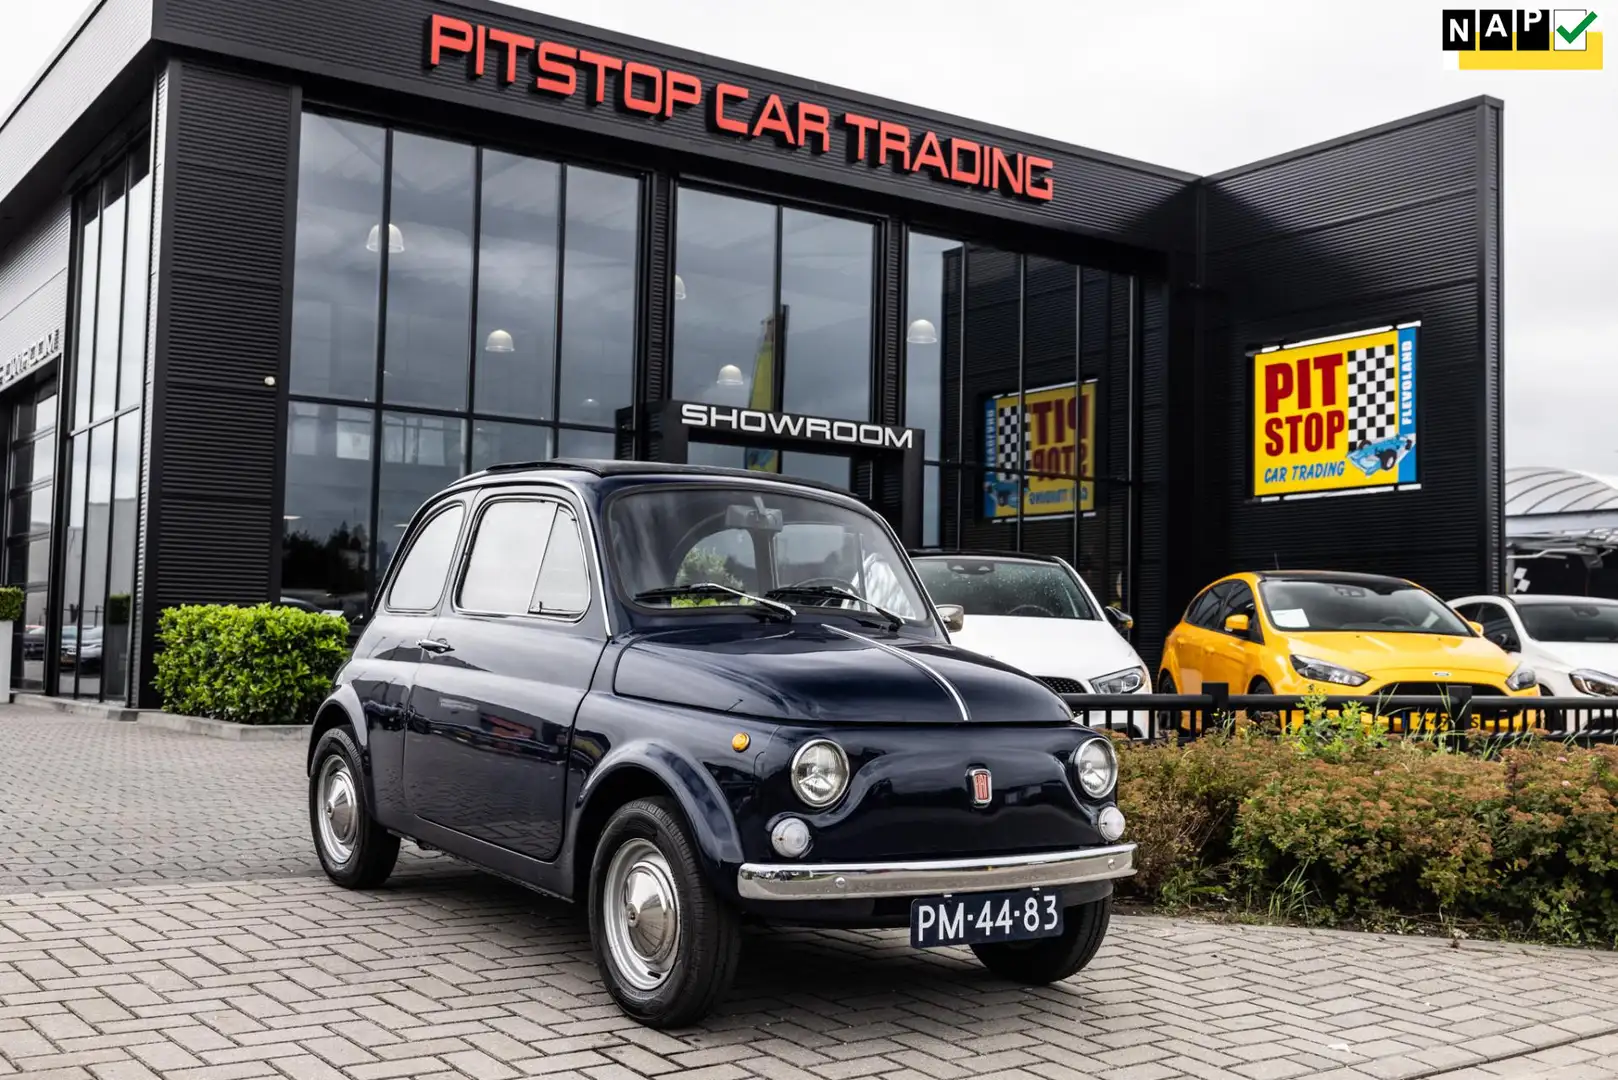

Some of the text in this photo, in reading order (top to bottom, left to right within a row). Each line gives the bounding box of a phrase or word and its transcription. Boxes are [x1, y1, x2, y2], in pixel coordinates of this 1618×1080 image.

[431, 14, 1054, 201] PITSTOP CAR TRADING
[1265, 353, 1343, 414] PIT
[1401, 341, 1414, 426] FLEVOLAND
[681, 403, 913, 449] SHOWROOM
[1265, 410, 1345, 457] STOP
[1264, 461, 1345, 484] CAR TRADING
